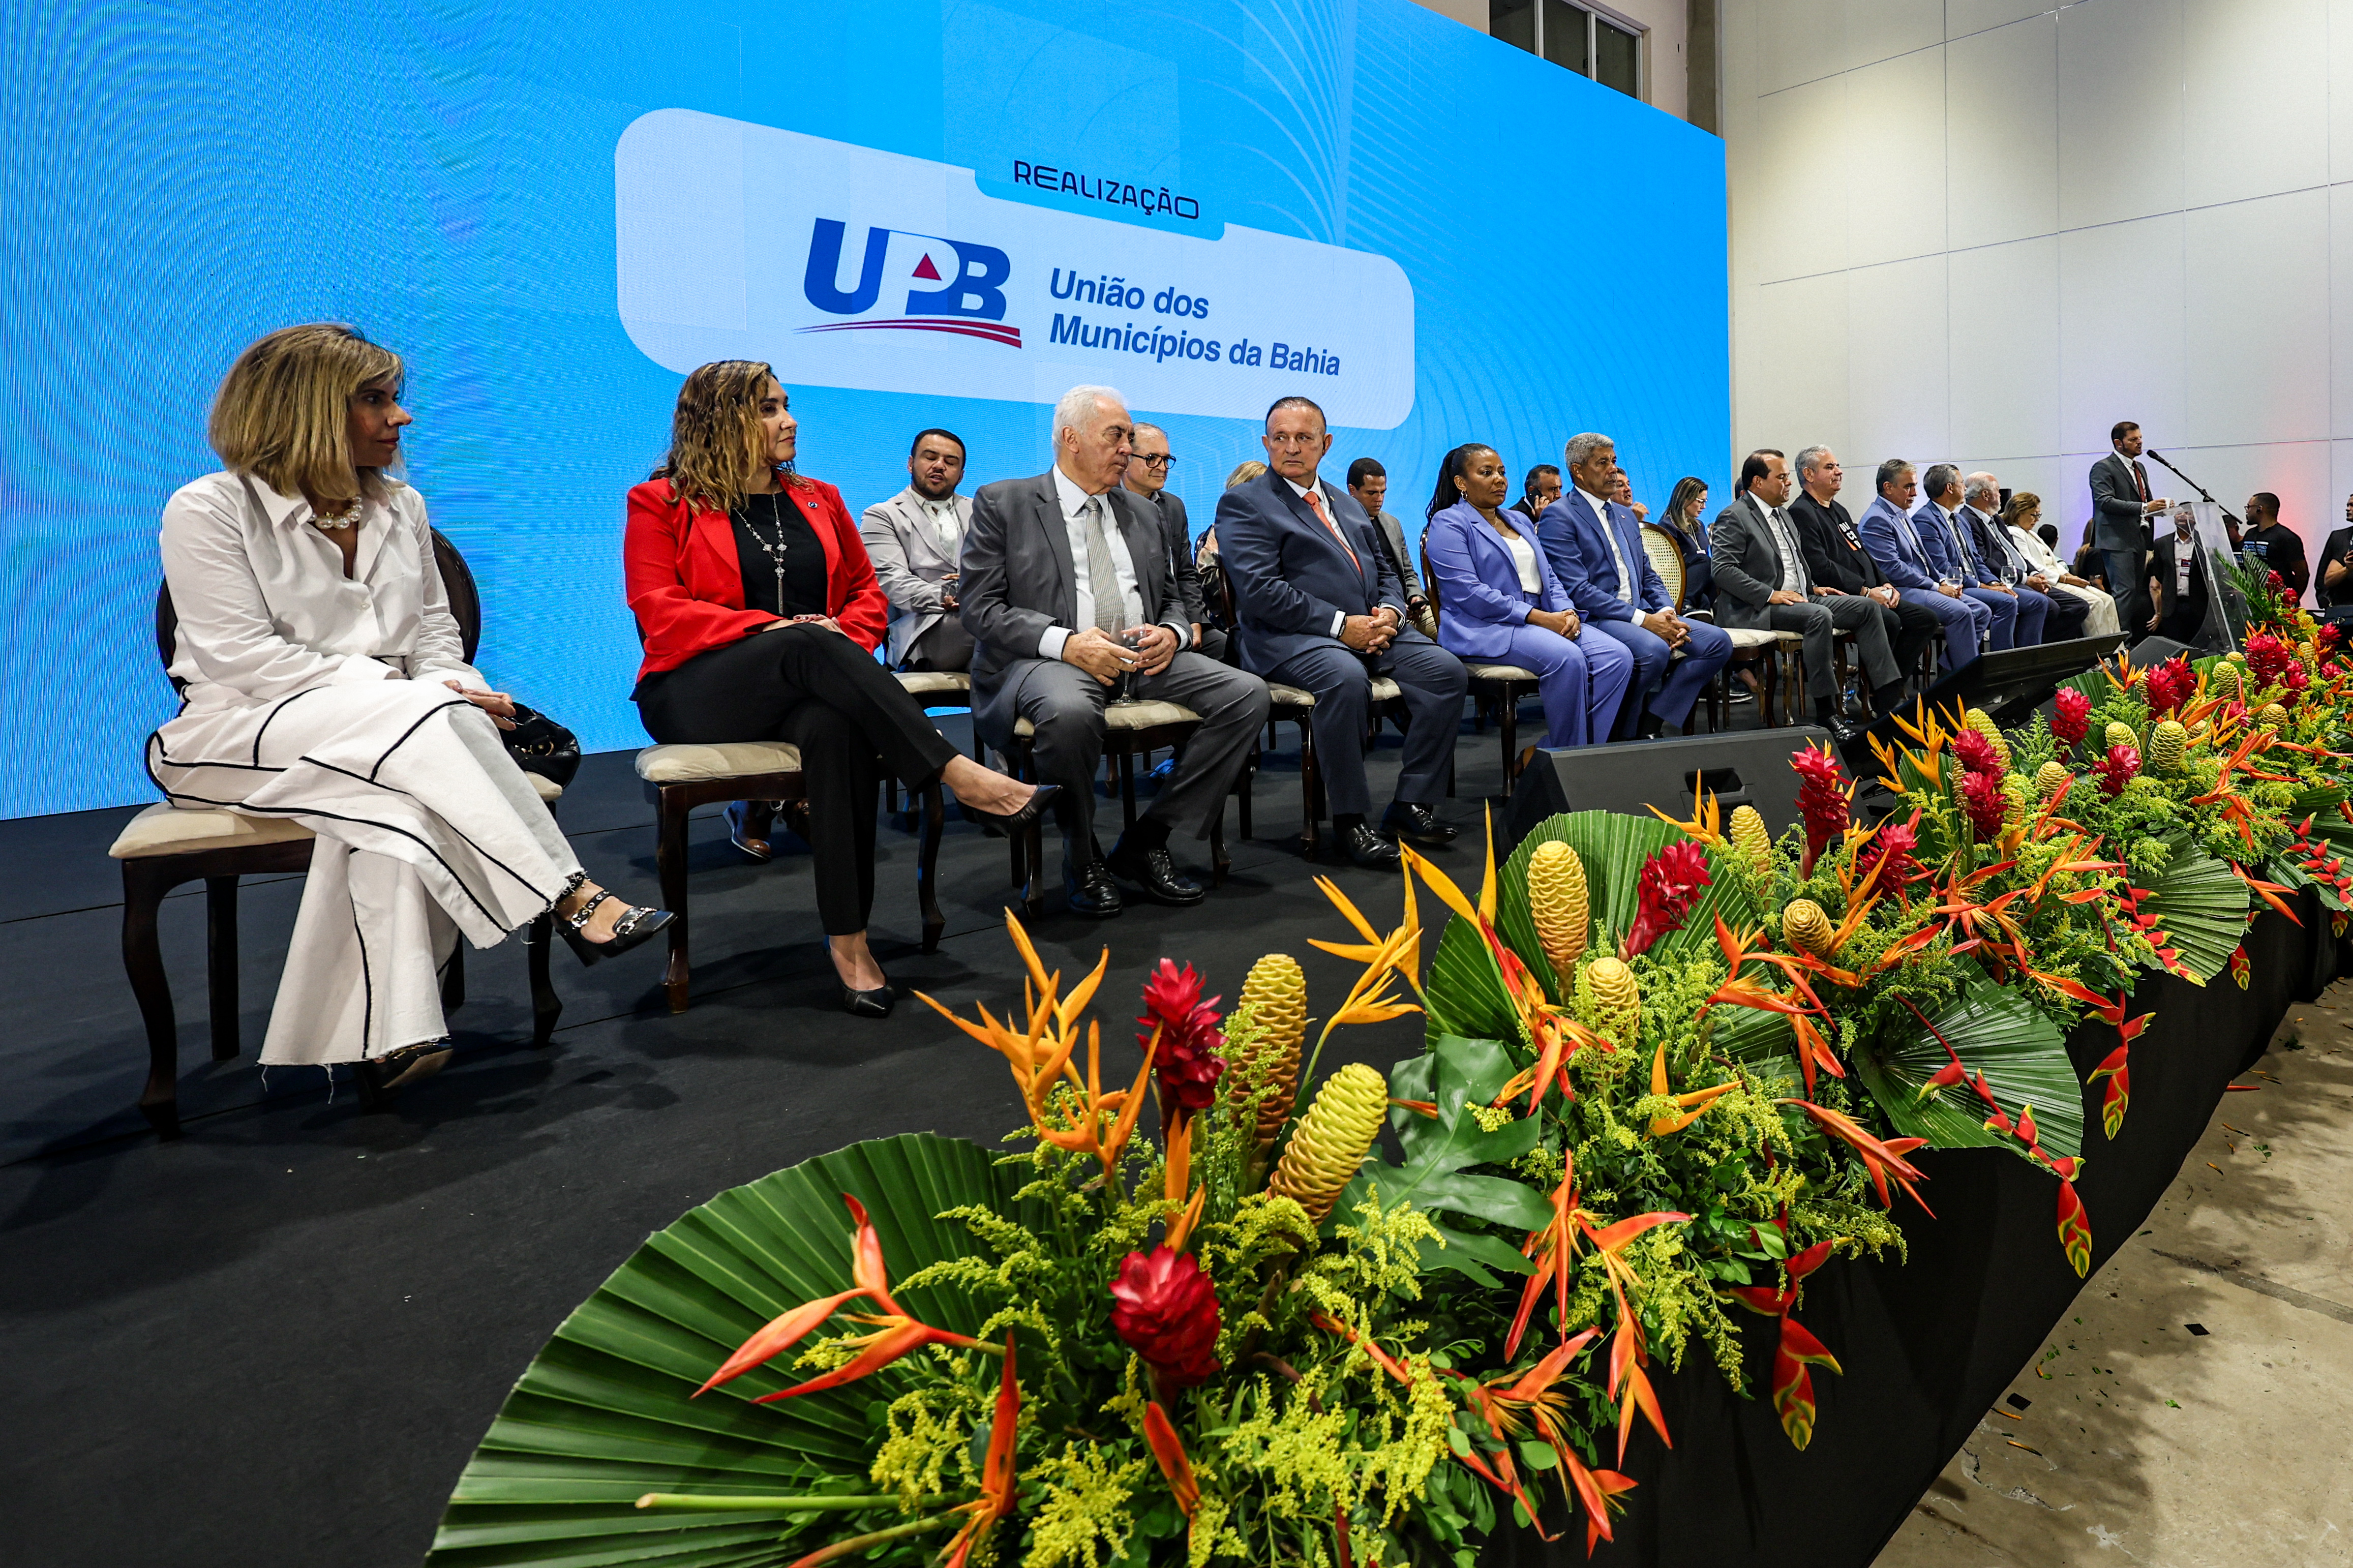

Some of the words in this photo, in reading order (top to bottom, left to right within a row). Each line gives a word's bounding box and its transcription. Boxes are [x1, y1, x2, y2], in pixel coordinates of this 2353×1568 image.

[1014, 159, 1200, 220] REALIZAÇÃO
[803, 217, 1011, 321] UPB
[1050, 267, 1145, 310] União
[1153, 286, 1209, 319] dos
[1049, 313, 1221, 364] Municípios
[1228, 338, 1262, 367] da
[1269, 342, 1340, 376] Bahia
